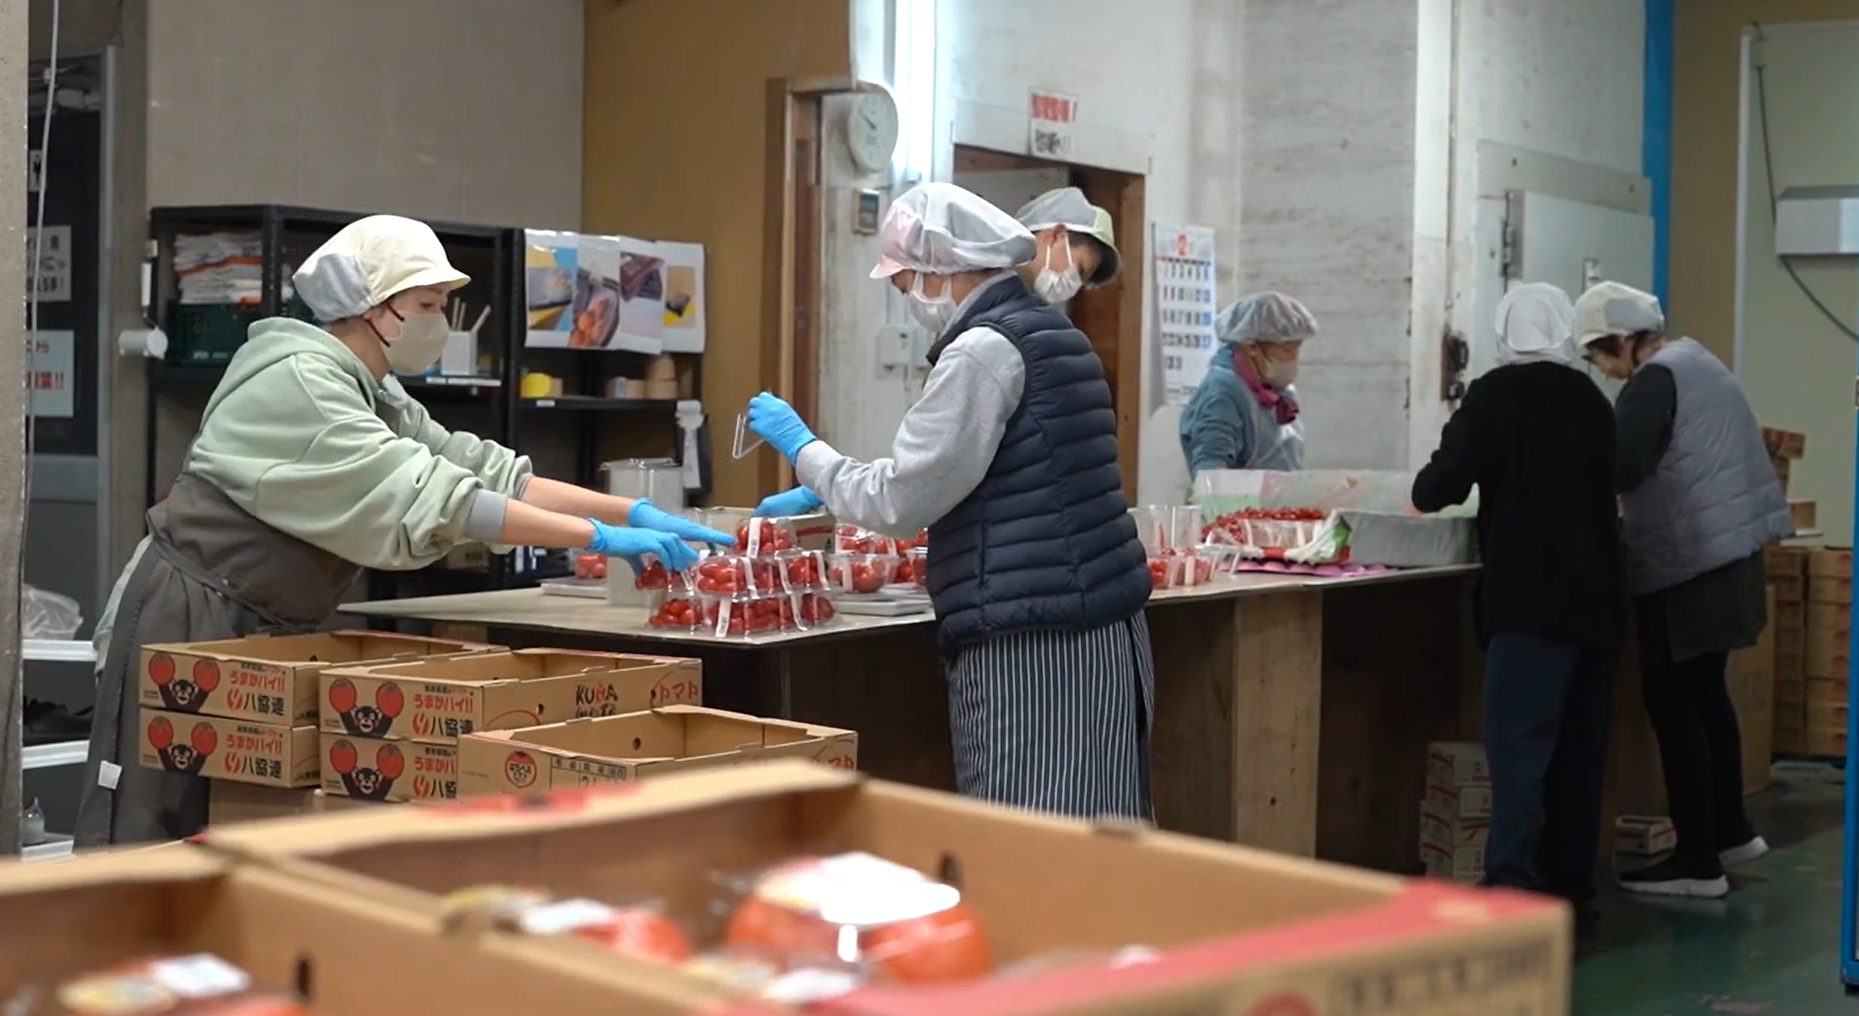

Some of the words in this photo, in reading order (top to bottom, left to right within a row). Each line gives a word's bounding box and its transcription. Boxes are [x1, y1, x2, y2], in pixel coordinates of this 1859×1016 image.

[575, 683, 618, 705] KUMA
[660, 680, 699, 703] トマト
